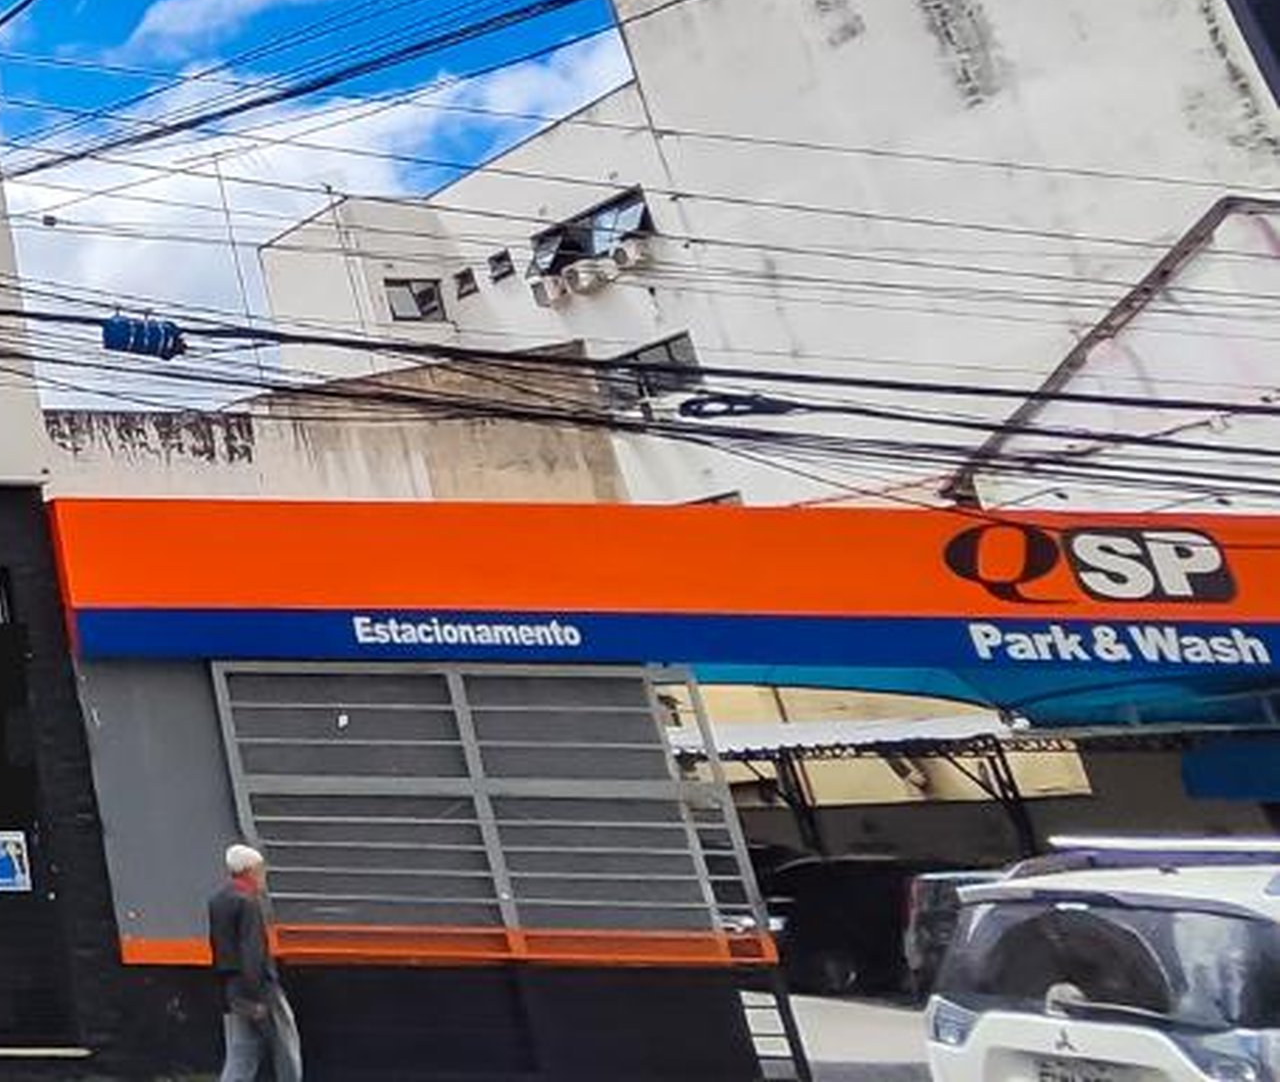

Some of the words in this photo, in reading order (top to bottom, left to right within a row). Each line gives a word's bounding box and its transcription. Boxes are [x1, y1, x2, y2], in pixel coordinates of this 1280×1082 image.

[943, 523, 1223, 605] QSP
[352, 615, 582, 647] Estacionamento
[968, 622, 1091, 662] Park
[1092, 624, 1133, 662] &
[1127, 624, 1272, 665] Wash
